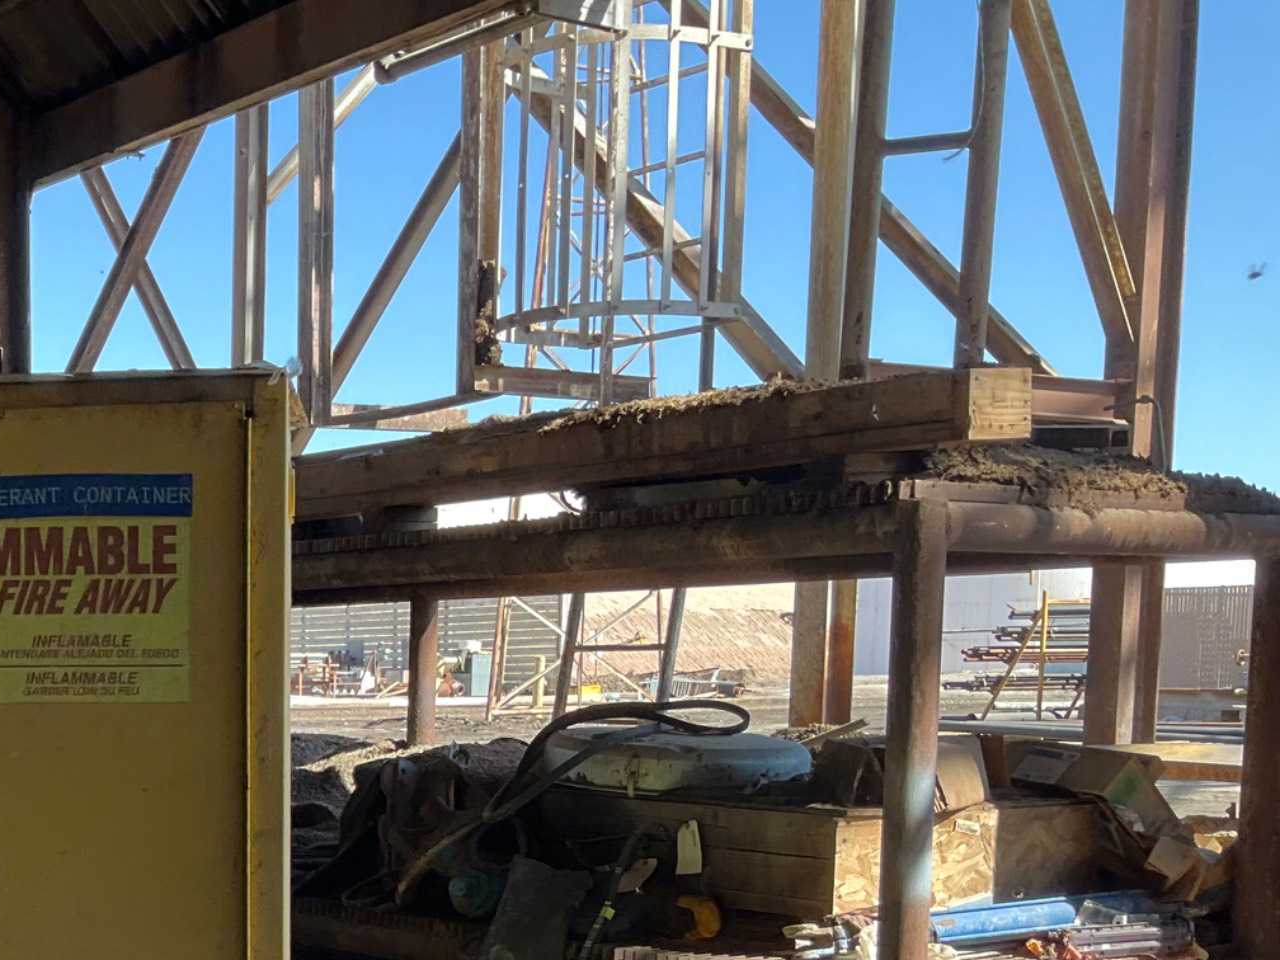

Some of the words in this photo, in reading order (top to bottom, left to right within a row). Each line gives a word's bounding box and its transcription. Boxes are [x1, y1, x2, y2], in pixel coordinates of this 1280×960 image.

[73, 485, 192, 505] CONTAINER
[73, 578, 179, 615] AWAY
[31, 634, 133, 648] INFLAMABLE
[25, 672, 139, 685] INFLAMMABLE
